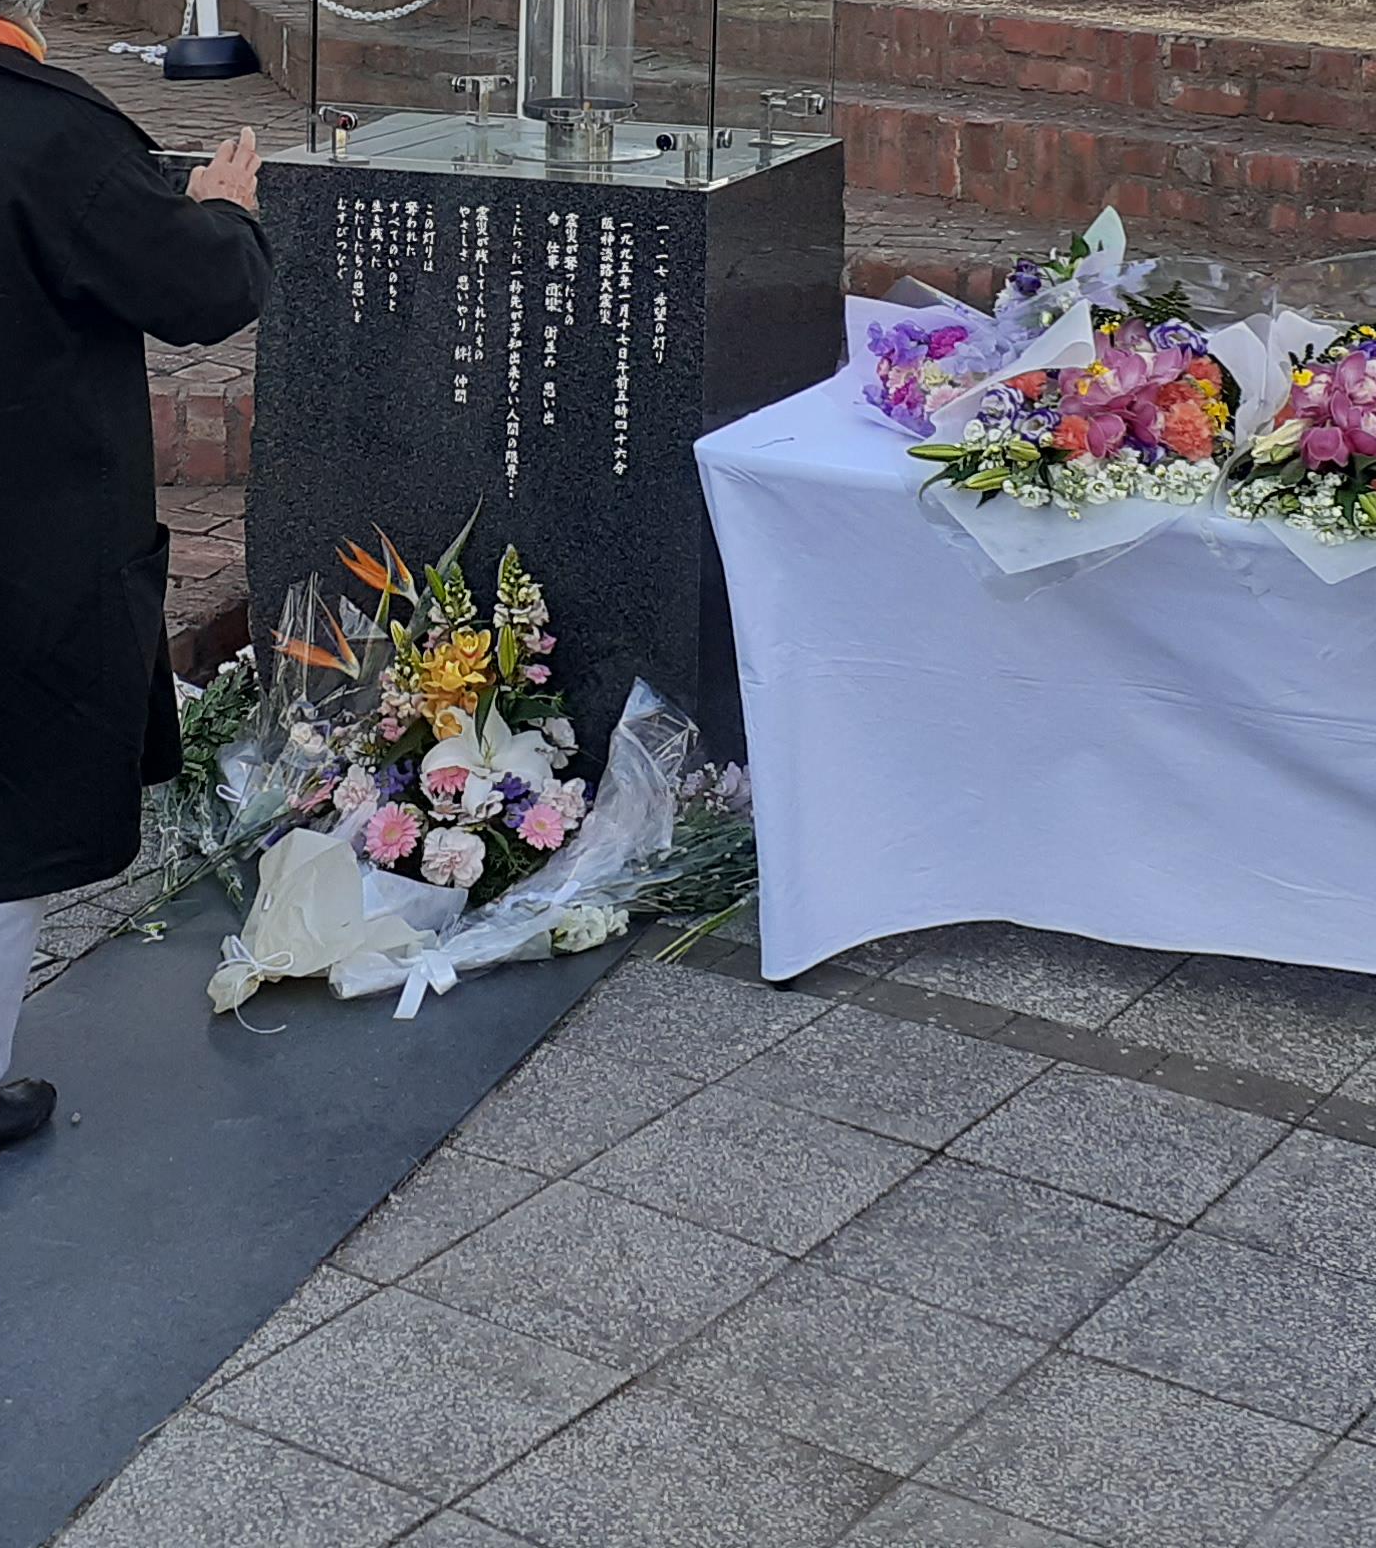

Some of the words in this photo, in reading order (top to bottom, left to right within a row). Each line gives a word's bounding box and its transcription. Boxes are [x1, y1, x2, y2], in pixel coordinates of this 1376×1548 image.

[336, 197, 349, 280] むすびつなぐ
[369, 199, 384, 268] 生き残った
[404, 201, 420, 257] 奪われた
[422, 203, 436, 272] この灯りは
[458, 206, 471, 262] やさしさ
[547, 211, 560, 227] 命
[351, 199, 366, 323] わたしたちの思いを
[387, 201, 401, 312] すべてのいのちと
[474, 205, 490, 360] 震災が残してくれたもの
[546, 240, 561, 270] 仕事
[563, 212, 580, 325] 震災が奪ったもの
[598, 216, 615, 325] 阪神淡路大震災
[456, 275, 470, 332] 思いやり
[652, 291, 668, 364] 希望の灯り
[543, 325, 559, 367] 街並み
[612, 221, 634, 476] 一九九五年一月十七日午前五時四十六分
[453, 374, 469, 404] 仲間
[542, 381, 556, 425] 思い出
